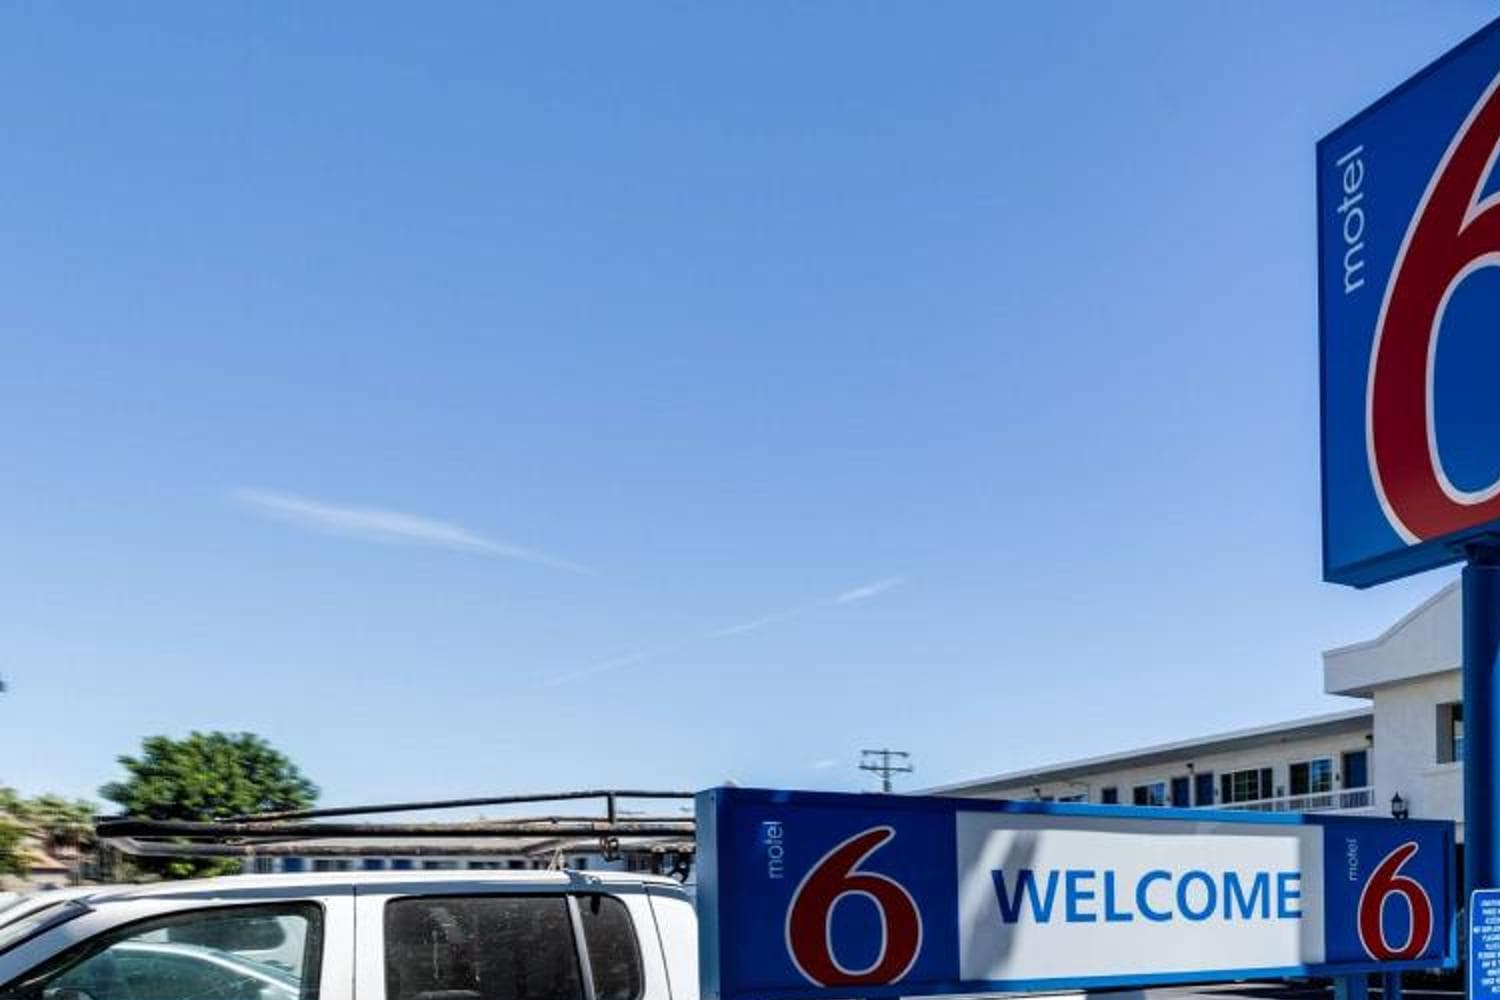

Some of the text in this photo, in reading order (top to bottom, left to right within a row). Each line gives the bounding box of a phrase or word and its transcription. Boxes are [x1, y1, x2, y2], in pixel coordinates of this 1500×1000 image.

[1336, 144, 1365, 294] motel
[762, 821, 922, 987] motel 6
[991, 869, 1303, 925] WELCOME
[1346, 838, 1434, 961] motel 6
